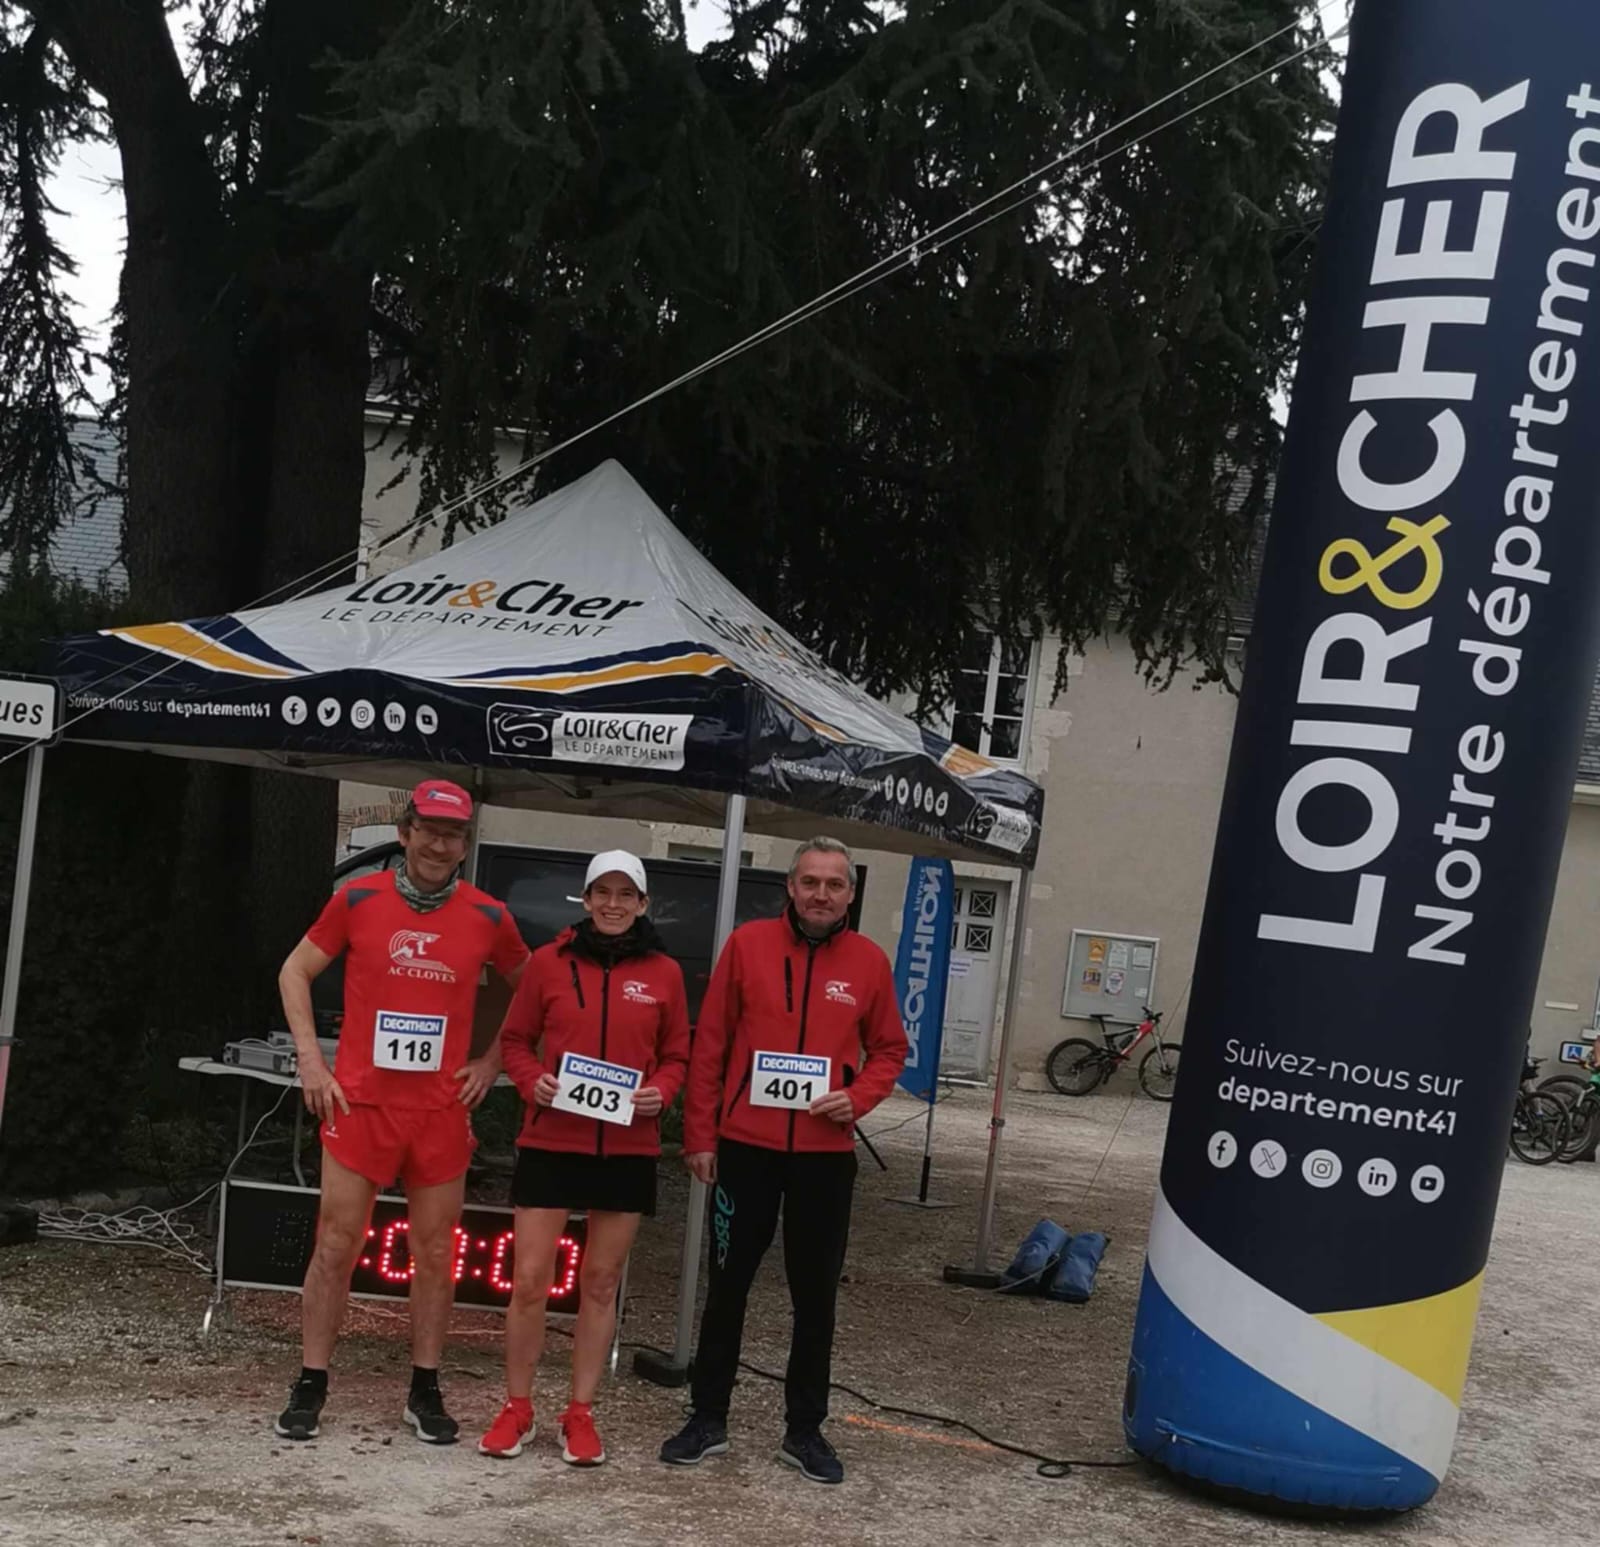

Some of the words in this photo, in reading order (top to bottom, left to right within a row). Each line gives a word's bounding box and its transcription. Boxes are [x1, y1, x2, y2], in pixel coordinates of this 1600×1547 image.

[1257, 78, 1530, 953] LOIR&CHER
[1407, 724, 1505, 966] Notre
[1458, 83, 1600, 696] département
[344, 573, 645, 620] Loir&Cher
[320, 607, 363, 622] LE
[143, 699, 163, 713] sur
[166, 699, 271, 718] departement41
[563, 717, 678, 745] Loir&Cher
[564, 740, 579, 752] LE
[387, 966, 406, 976] AC
[407, 968, 457, 983] CLOYES
[383, 1017, 440, 1033] DECATHLON
[387, 1038, 432, 1063] 118
[569, 1060, 635, 1086] DECATHLON
[762, 1057, 824, 1073] DECATHLON
[1223, 1038, 1410, 1091] Suivez-nous
[1416, 1072, 1464, 1098] sur
[568, 1082, 621, 1113] 403
[764, 1078, 813, 1102] 401
[1217, 1076, 1457, 1136] departement41
